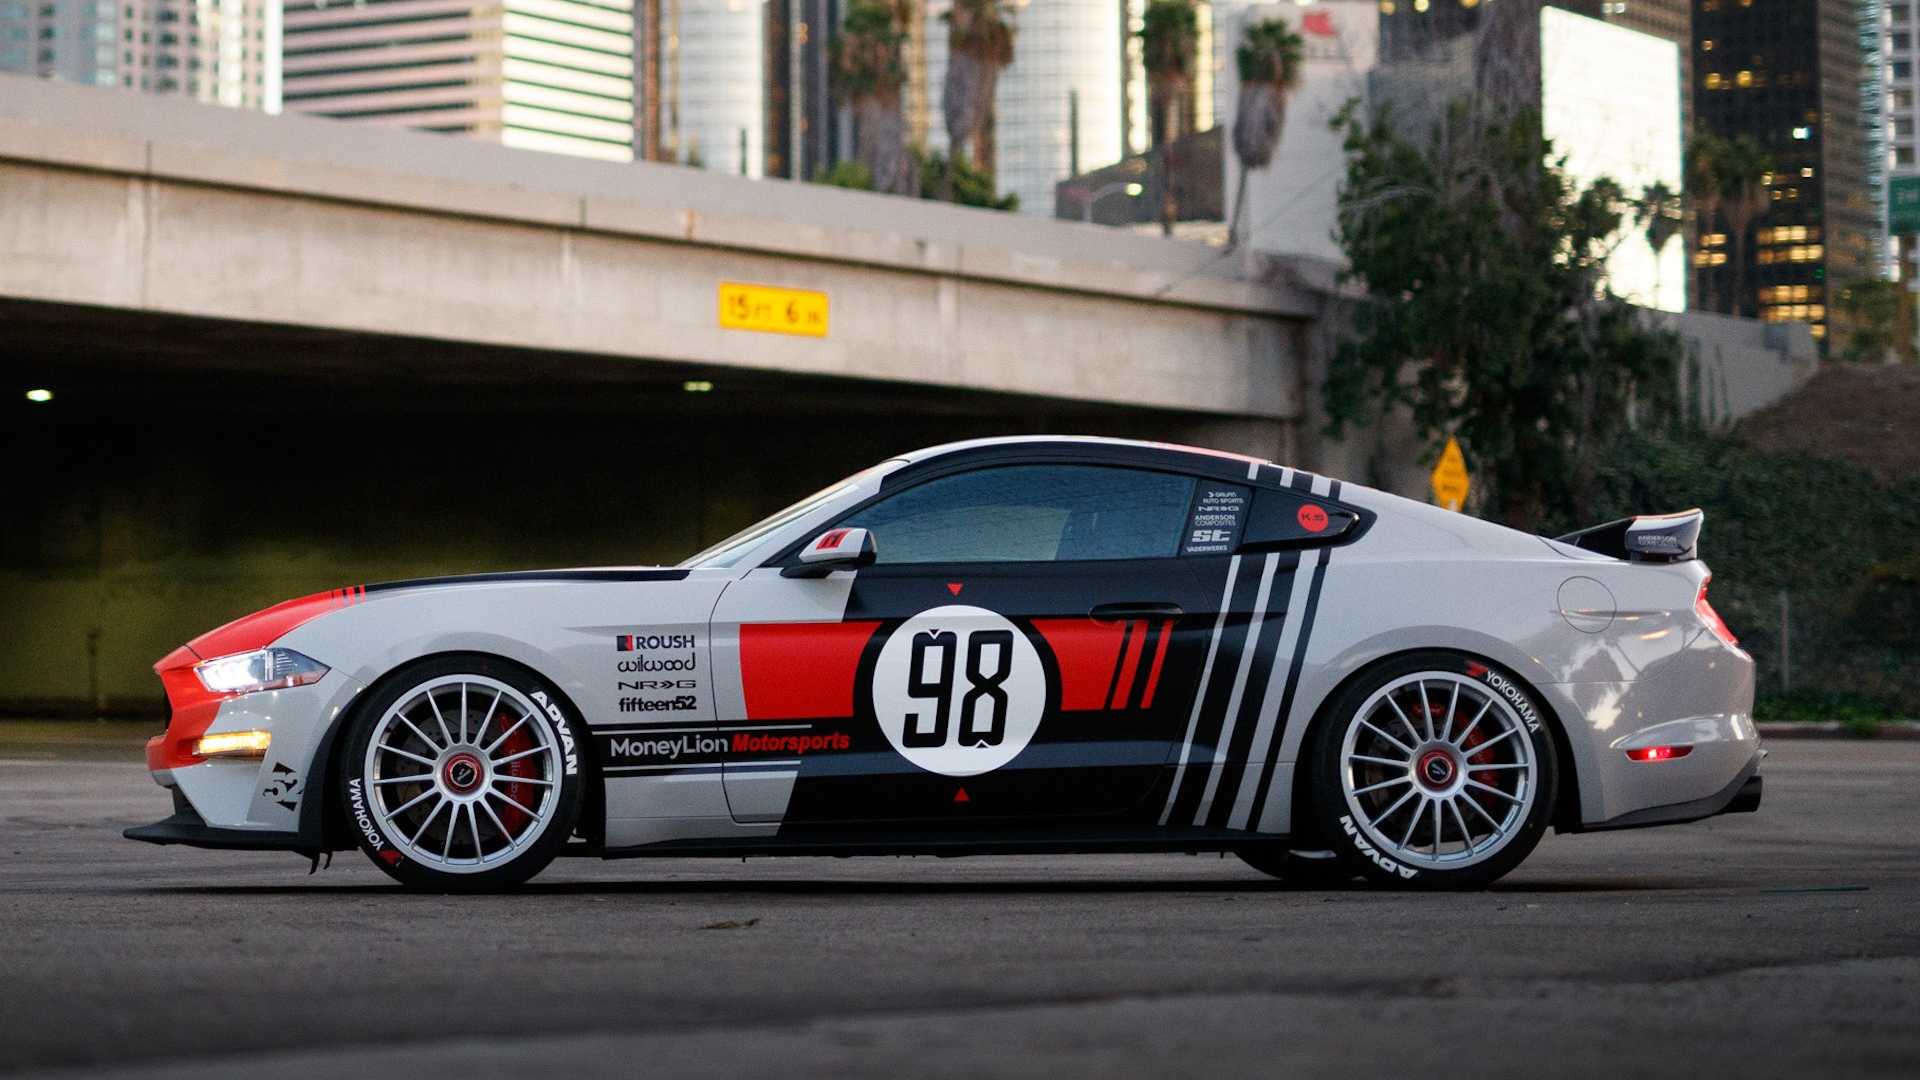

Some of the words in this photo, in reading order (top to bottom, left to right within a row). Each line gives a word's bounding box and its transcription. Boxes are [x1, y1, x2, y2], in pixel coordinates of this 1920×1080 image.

[784, 298, 800, 325] 6
[617, 652, 696, 672] wilwood
[636, 635, 695, 649] ROUSH
[619, 696, 697, 712] fifteen52
[902, 629, 1014, 748] 98
[1486, 670, 1540, 733] YOKOHAMA
[530, 691, 577, 775] ADVAN
[610, 735, 728, 759] MoneyLion
[732, 732, 850, 753] Motorsports
[349, 778, 385, 851] YOKOHAMA
[1339, 815, 1418, 879] ADVAN
